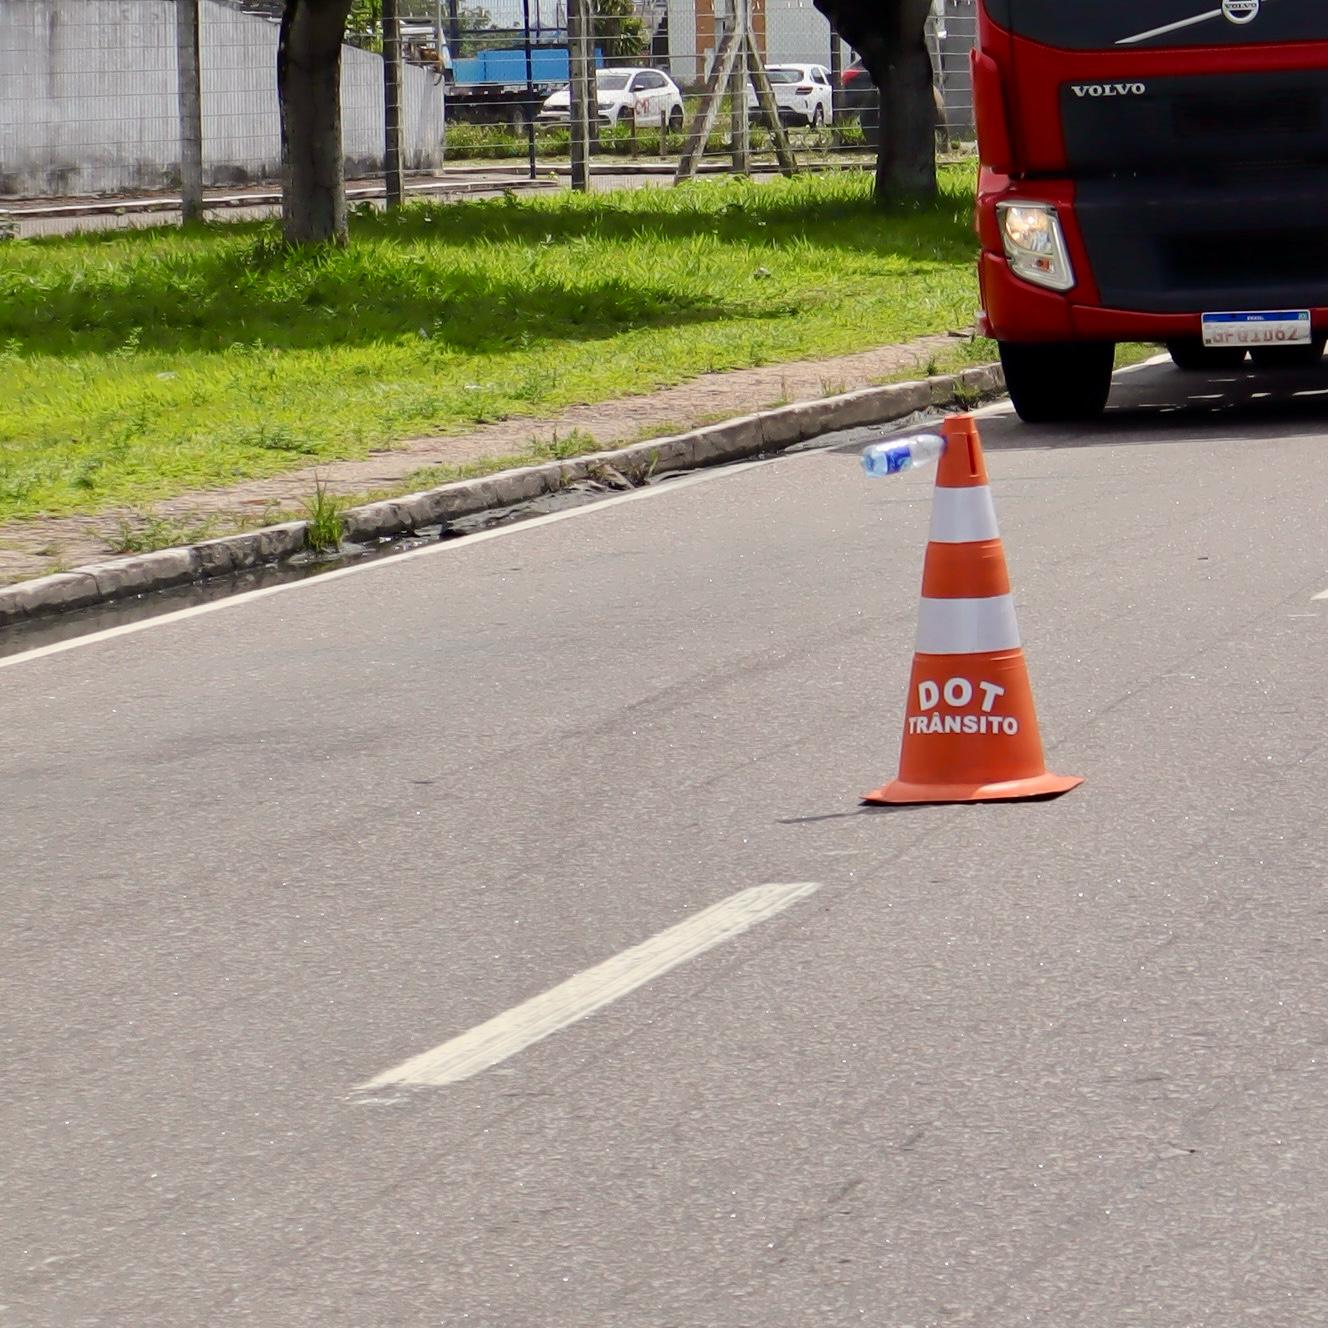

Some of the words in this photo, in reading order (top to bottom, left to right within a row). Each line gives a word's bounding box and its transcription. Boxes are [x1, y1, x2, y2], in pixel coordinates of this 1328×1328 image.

[1070, 82, 1146, 97] VOLVO
[918, 677, 1005, 712] DOT
[908, 711, 1019, 735] TRÂNSITO
